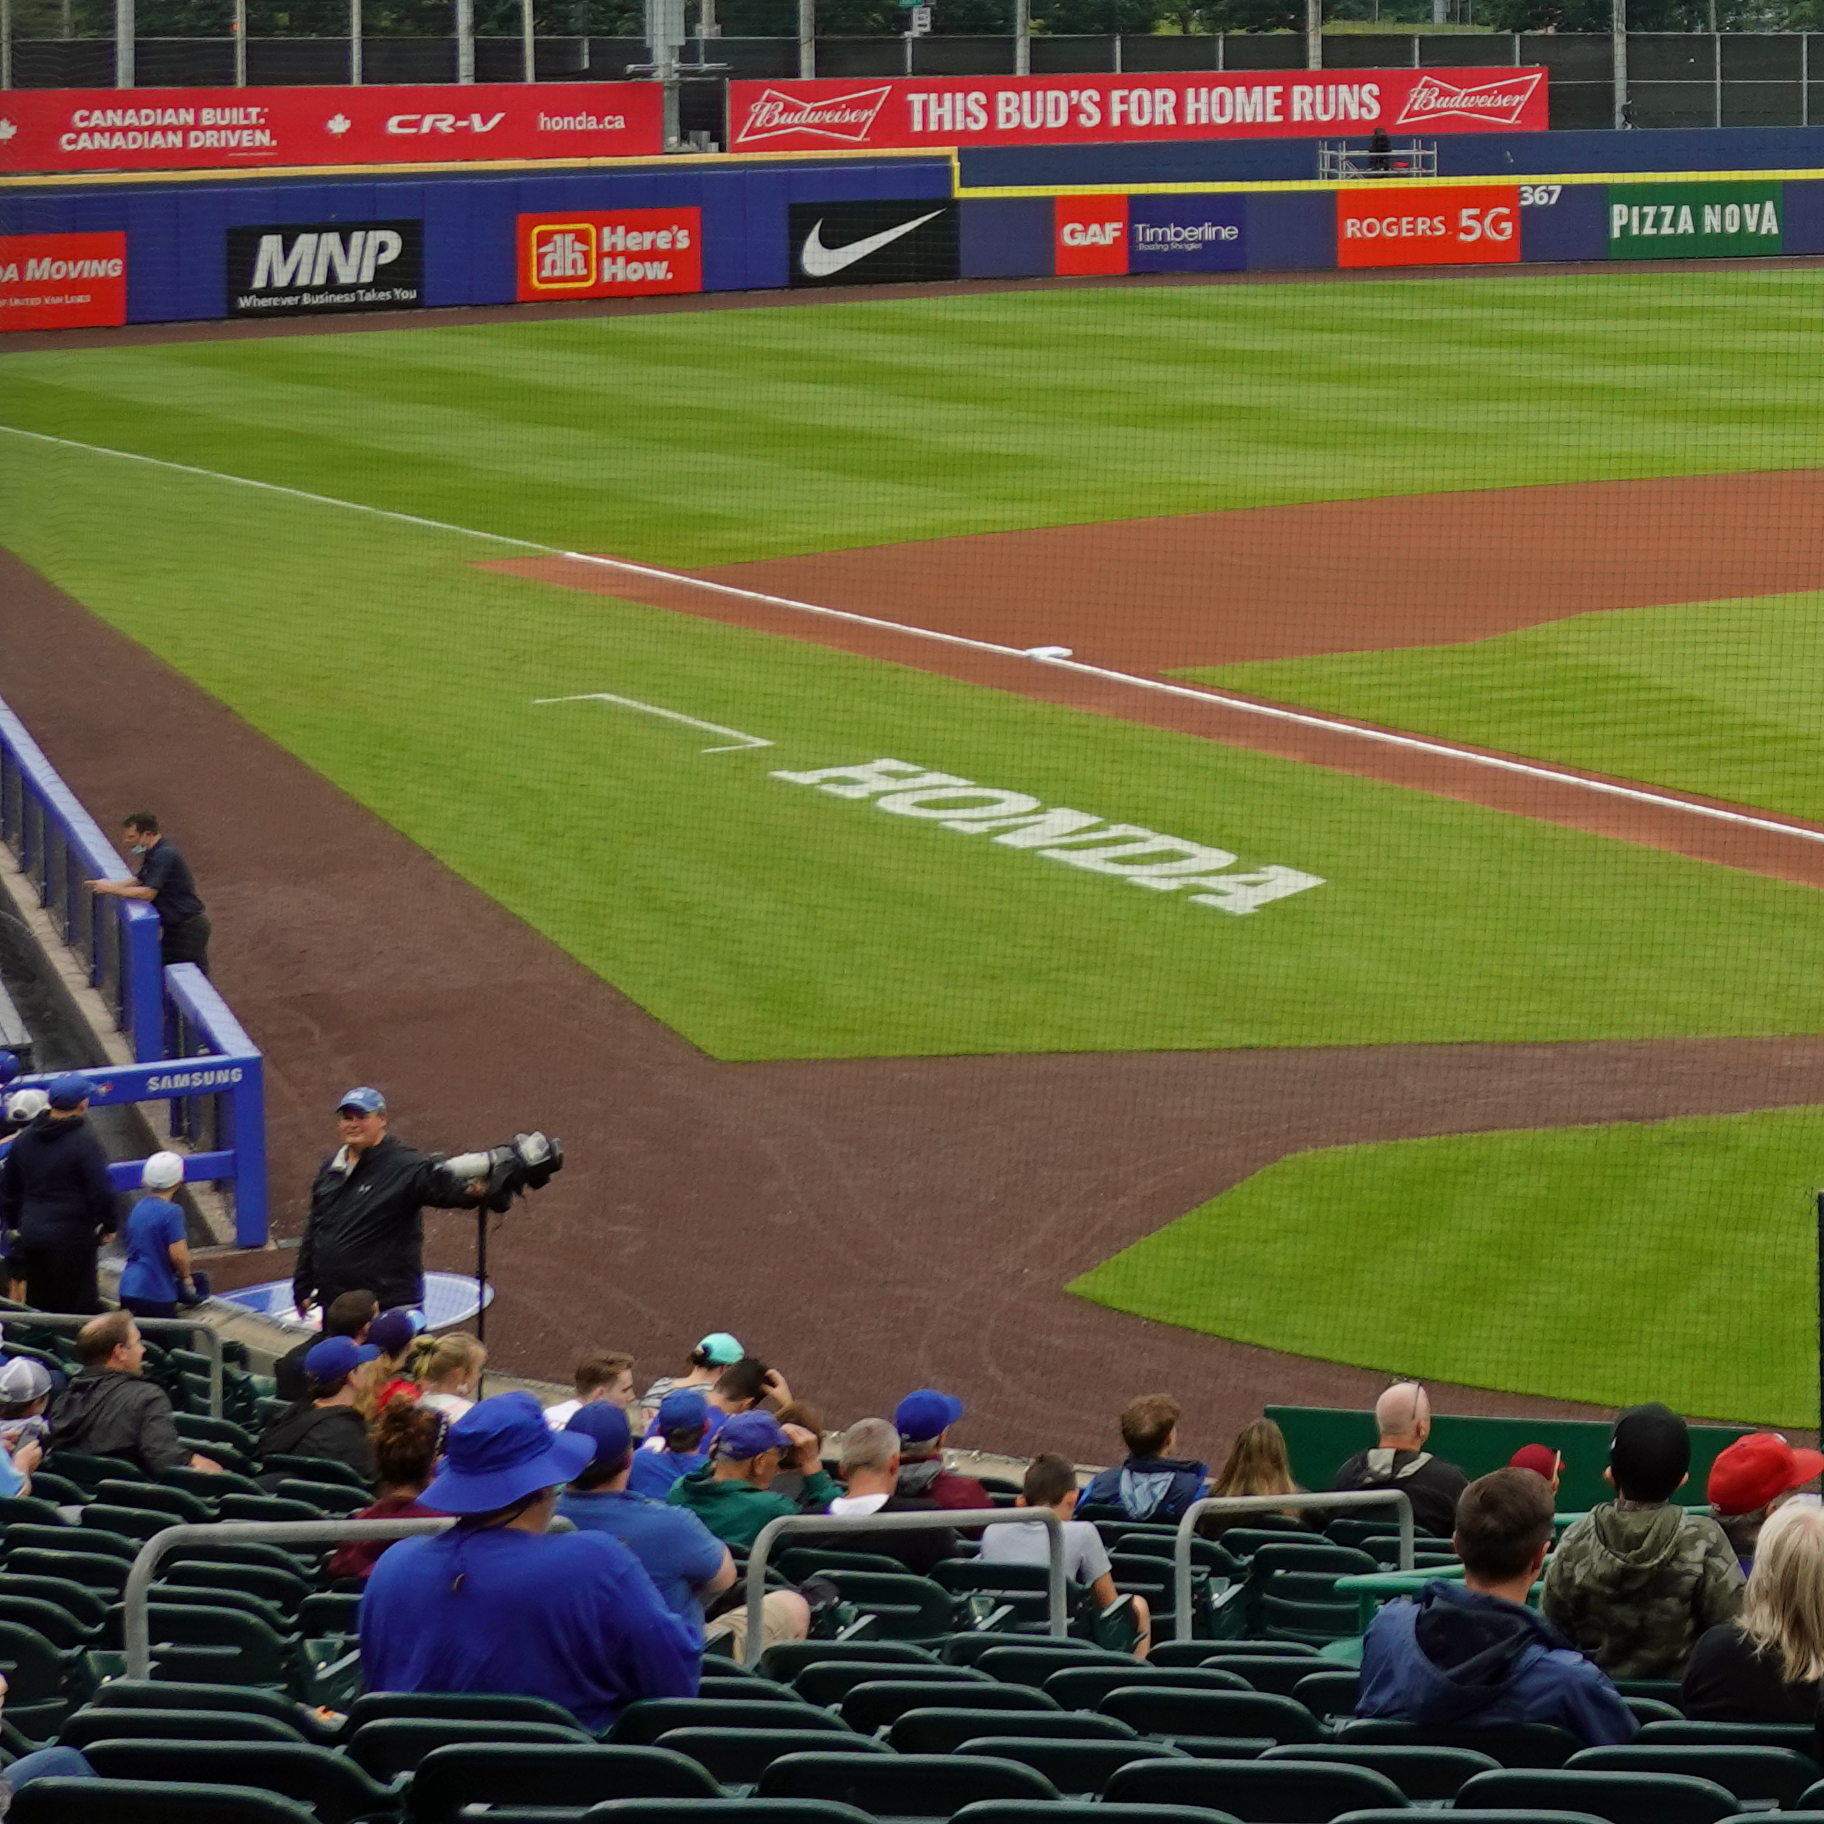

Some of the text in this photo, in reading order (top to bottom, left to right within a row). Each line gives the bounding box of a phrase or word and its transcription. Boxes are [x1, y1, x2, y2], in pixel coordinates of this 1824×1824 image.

[907, 82, 1381, 132] THIS BUD'S FOR HOME RUNS
[1408, 87, 1528, 111] Budweiser
[72, 108, 195, 128] CANADIAN
[387, 112, 506, 134] CR-V
[538, 111, 626, 131] honda.ca
[749, 102, 877, 128] Budweiser
[60, 129, 278, 151] CANADIAN DRIVEN.
[1518, 185, 1562, 206] 367
[1345, 207, 1513, 242] ROGERS 5G
[1611, 199, 1780, 239] PIZZA NOVA
[602, 225, 691, 252] Here's
[1062, 222, 1123, 247] GAF
[1134, 222, 1239, 242] Timberline
[250, 229, 403, 290] MNP
[602, 256, 674, 283] How.
[238, 287, 417, 309] Wherever Business Takes You
[769, 758, 1328, 916] HONDA
[147, 1067, 243, 1092] SAMSUNG
